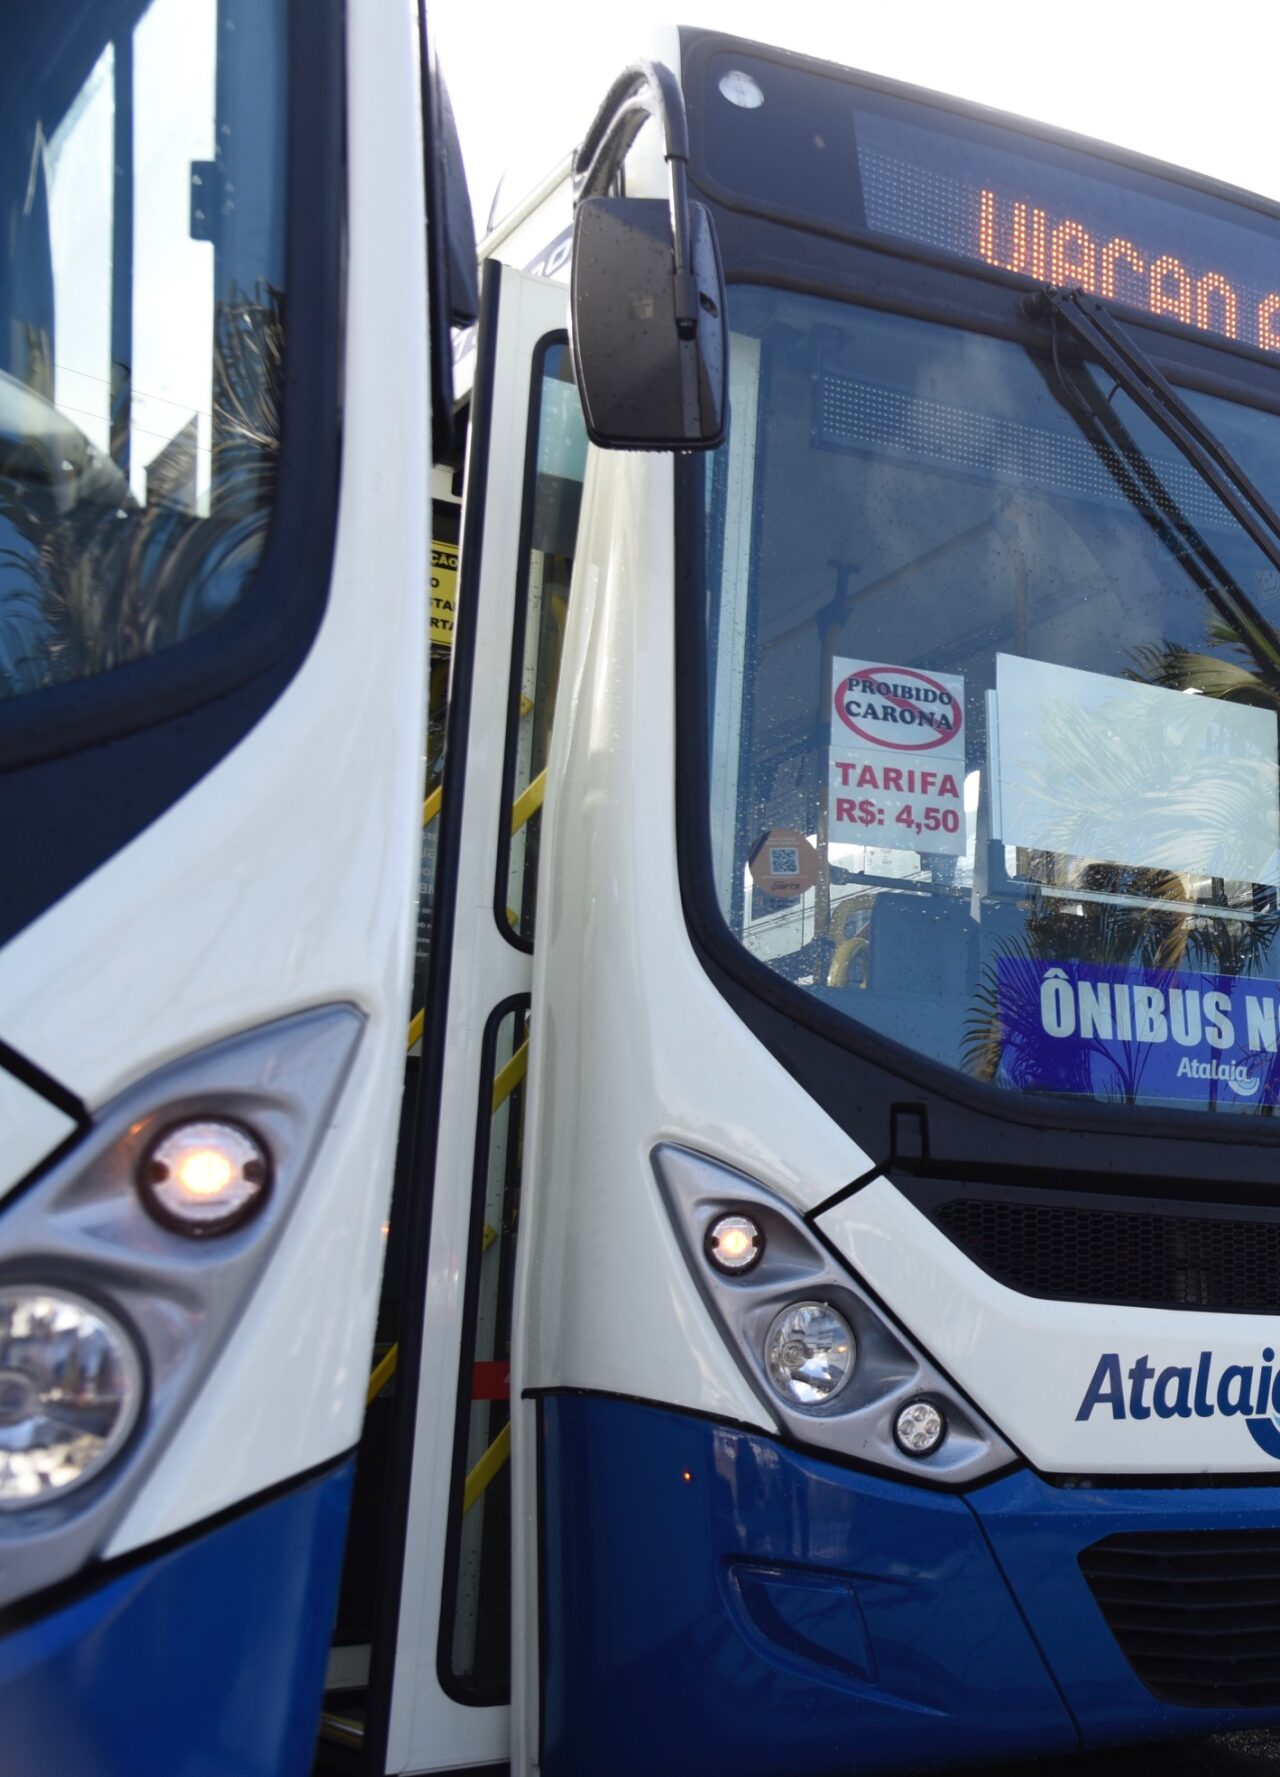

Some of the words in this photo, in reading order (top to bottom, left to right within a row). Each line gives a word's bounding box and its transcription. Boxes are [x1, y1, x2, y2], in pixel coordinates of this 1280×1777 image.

[847, 676, 954, 706] PROIBIDO
[845, 701, 954, 731] CARONA
[835, 761, 960, 799] TARIFA
[836, 797, 885, 827] R$:
[895, 804, 960, 836] 4,50
[1039, 967, 1236, 1051] ÔNIBUS
[1176, 1056, 1253, 1085] Atalaia
